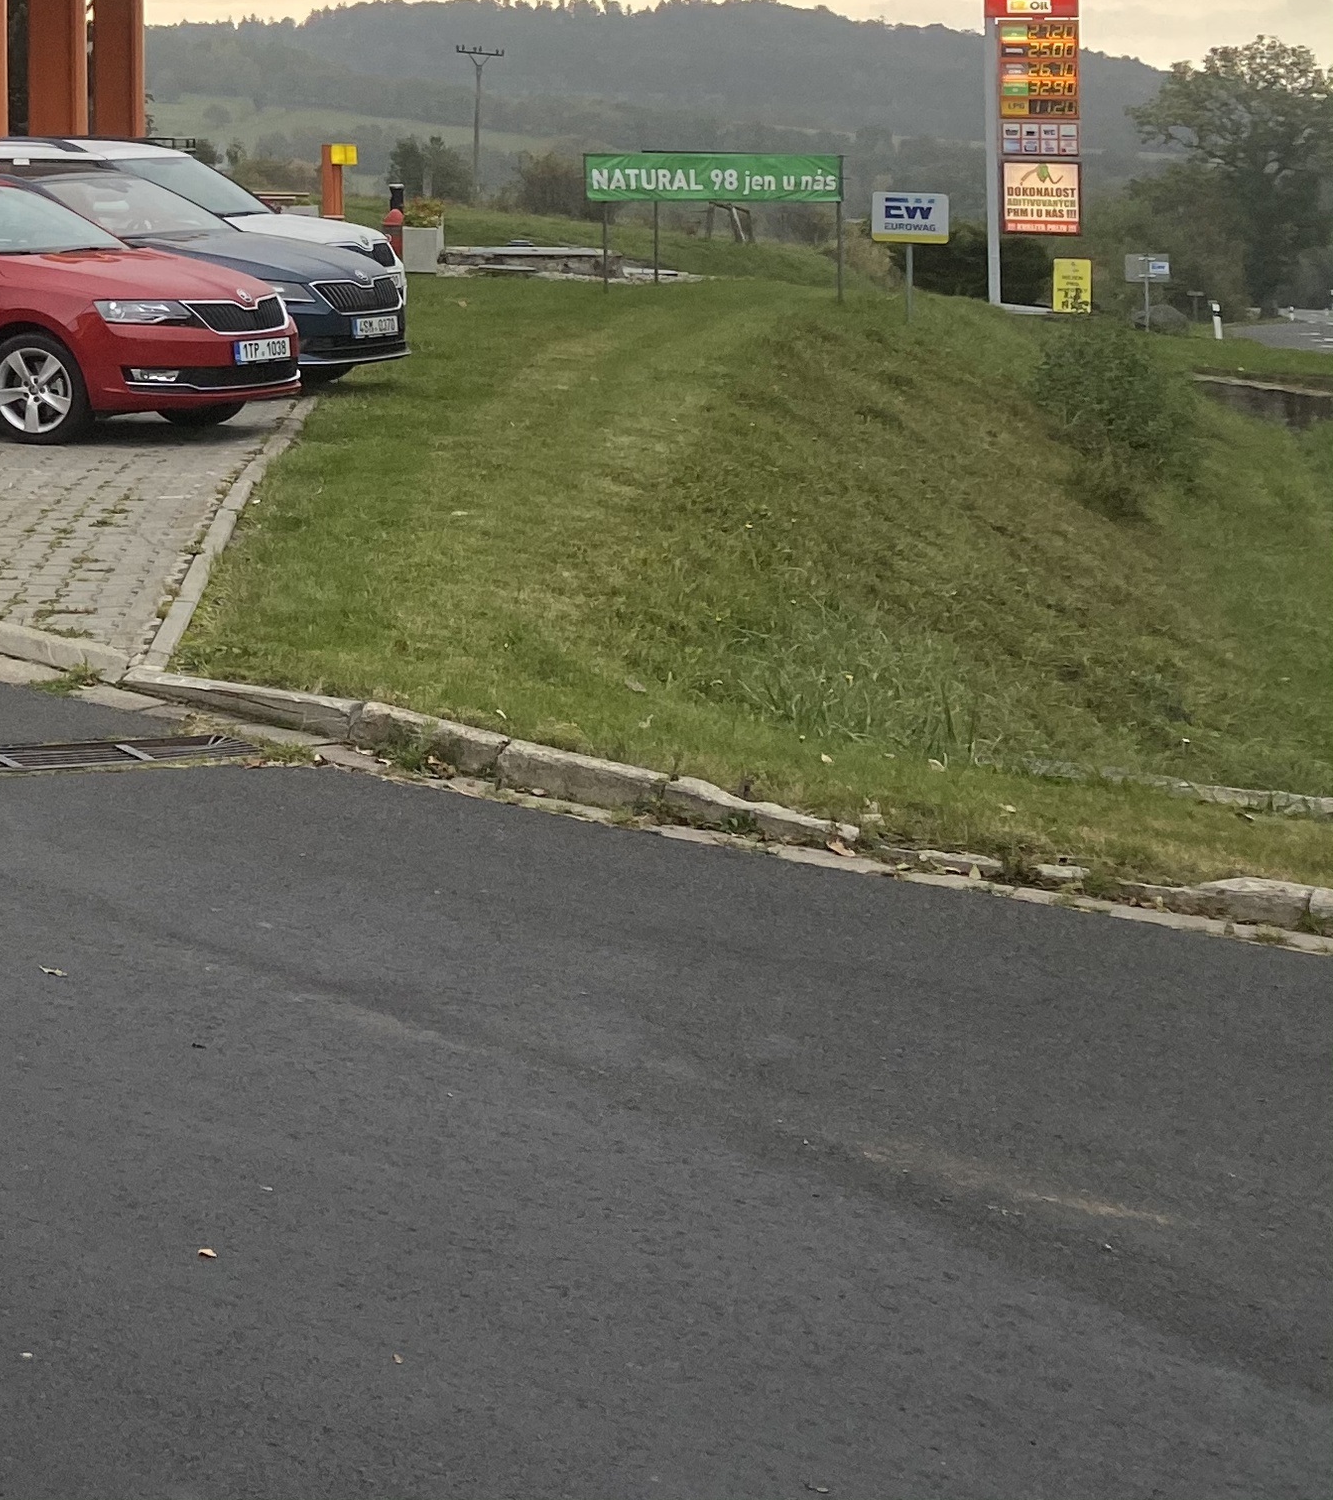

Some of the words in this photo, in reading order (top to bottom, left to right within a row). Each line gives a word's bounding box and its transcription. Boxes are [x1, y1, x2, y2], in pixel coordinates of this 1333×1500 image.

[1008, 102, 1025, 110] LPG
[591, 168, 704, 190] NATURAL
[710, 168, 738, 191] 98
[743, 170, 776, 195] jen
[783, 175, 795, 191] u
[801, 168, 837, 191] nás
[1007, 186, 1076, 198] DOKONALOST
[1007, 208, 1029, 217] PHM
[1036, 209, 1043, 218] U
[1045, 207, 1065, 218] NÁS
[884, 222, 936, 232] EUROWAG
[242, 341, 259, 359] 1TP
[267, 340, 287, 357] 1038
